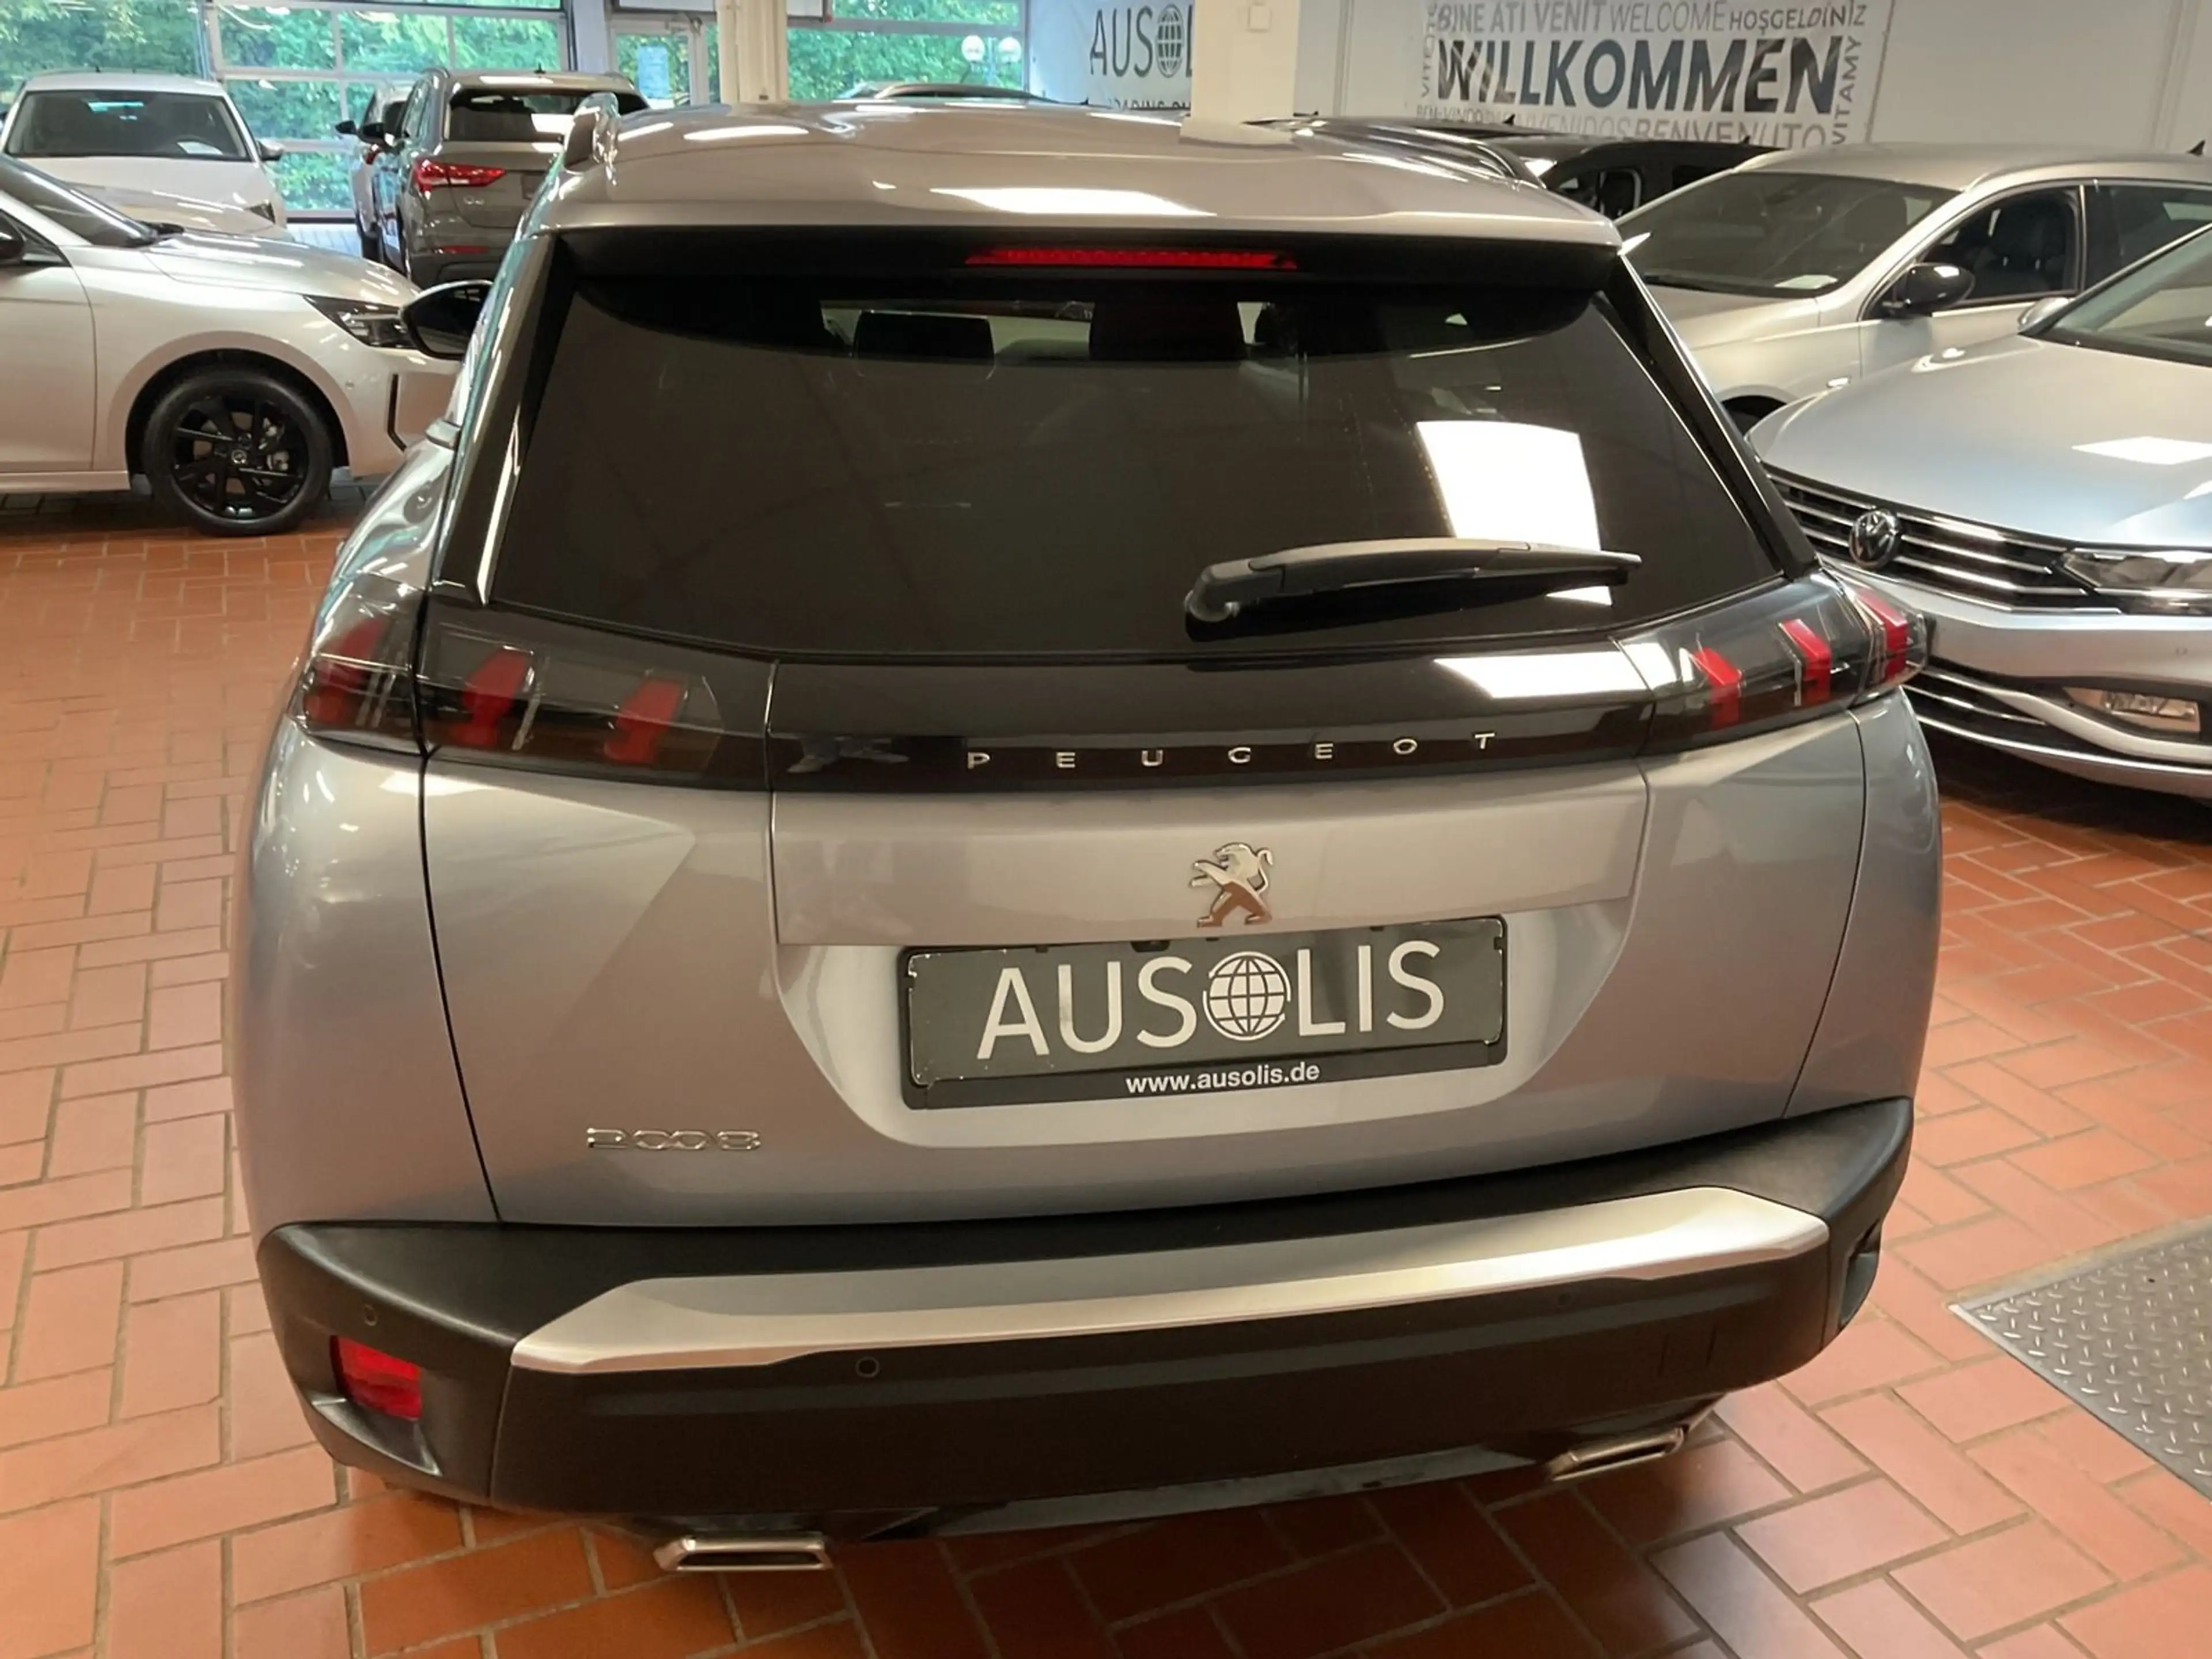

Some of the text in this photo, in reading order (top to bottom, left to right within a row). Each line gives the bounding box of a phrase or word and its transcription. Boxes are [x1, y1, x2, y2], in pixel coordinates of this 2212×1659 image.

[1533, 0, 1607, 32] VENIT
[1610, 0, 1726, 32] WELCOME
[1438, 36, 1842, 114] WILLKOMMEN
[968, 732, 1495, 770] PEUGEOT
[1126, 1061, 1320, 1093] www.ausolis.de
[586, 1127, 762, 1150] 2008
